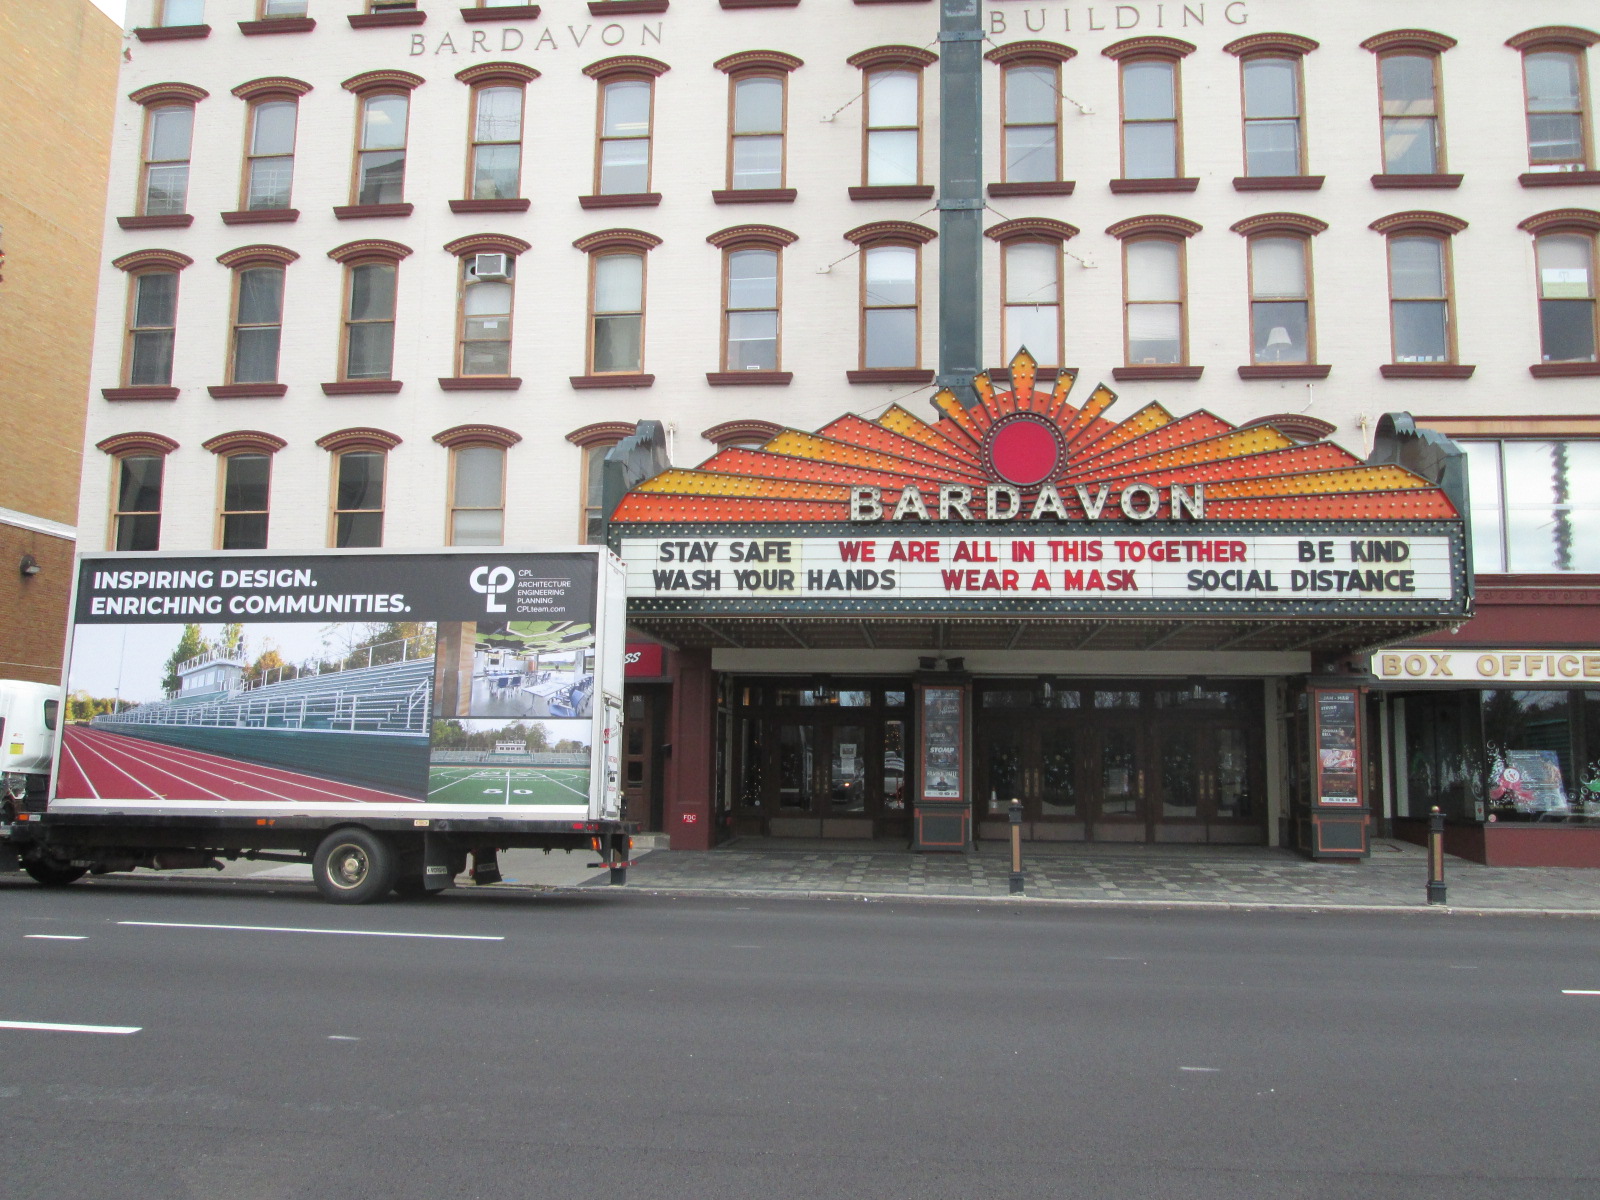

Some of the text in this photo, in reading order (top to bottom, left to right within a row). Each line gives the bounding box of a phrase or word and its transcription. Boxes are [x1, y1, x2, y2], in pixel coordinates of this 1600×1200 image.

[409, 2, 1248, 56] BARDAVON BUILDING
[849, 483, 1205, 521] BARDAVON
[660, 541, 791, 563] STAY SAFE
[838, 541, 1247, 563] WE ARE ALL IN THIS TOGETHER
[1298, 541, 1410, 563] BE KIND
[94, 569, 317, 589] INSPIRING DESIGN.
[652, 569, 896, 591] WASH YOUR HANDS
[941, 569, 1138, 591] WEAR A MASK
[1187, 569, 1415, 592] SOCIAL DISTANCE
[91, 594, 411, 615] ENRICHING COMMUNITIES.
[1382, 654, 1600, 677] BOX OFFICE
